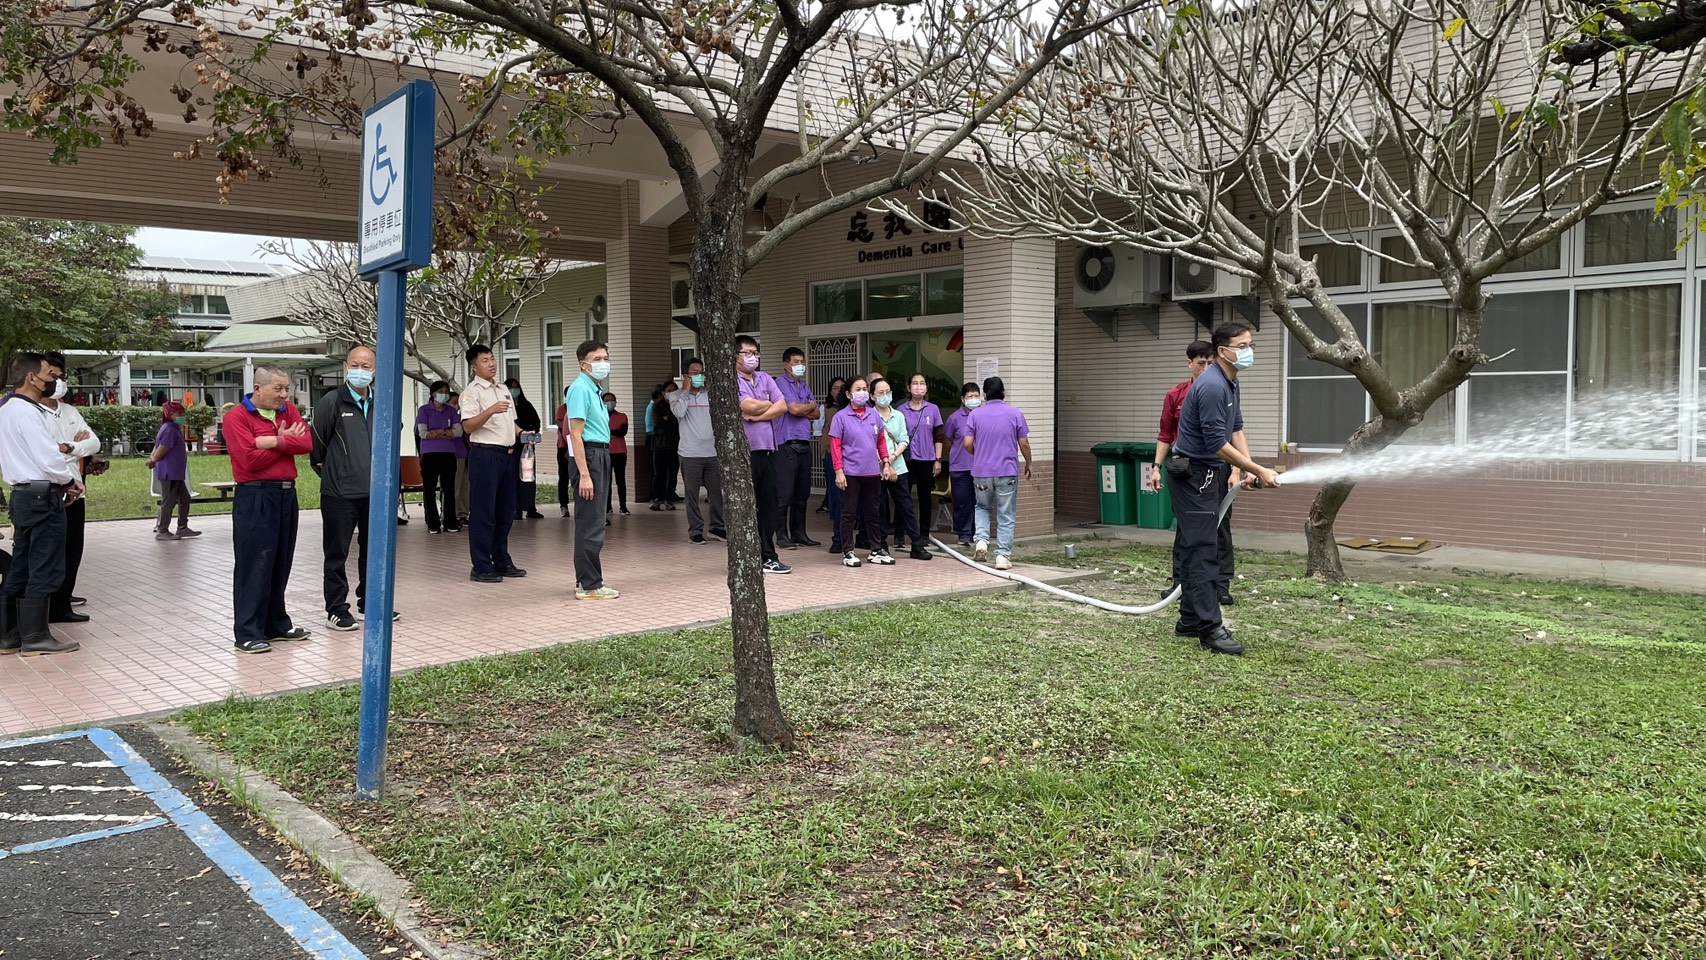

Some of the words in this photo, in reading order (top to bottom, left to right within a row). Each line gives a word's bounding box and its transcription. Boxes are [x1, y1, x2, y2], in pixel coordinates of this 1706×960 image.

[364, 208, 401, 239] 專用停車位
[379, 237, 392, 247] Parking
[393, 233, 401, 242] Only
[858, 244, 913, 263] Dementia
[920, 240, 951, 255] Care
